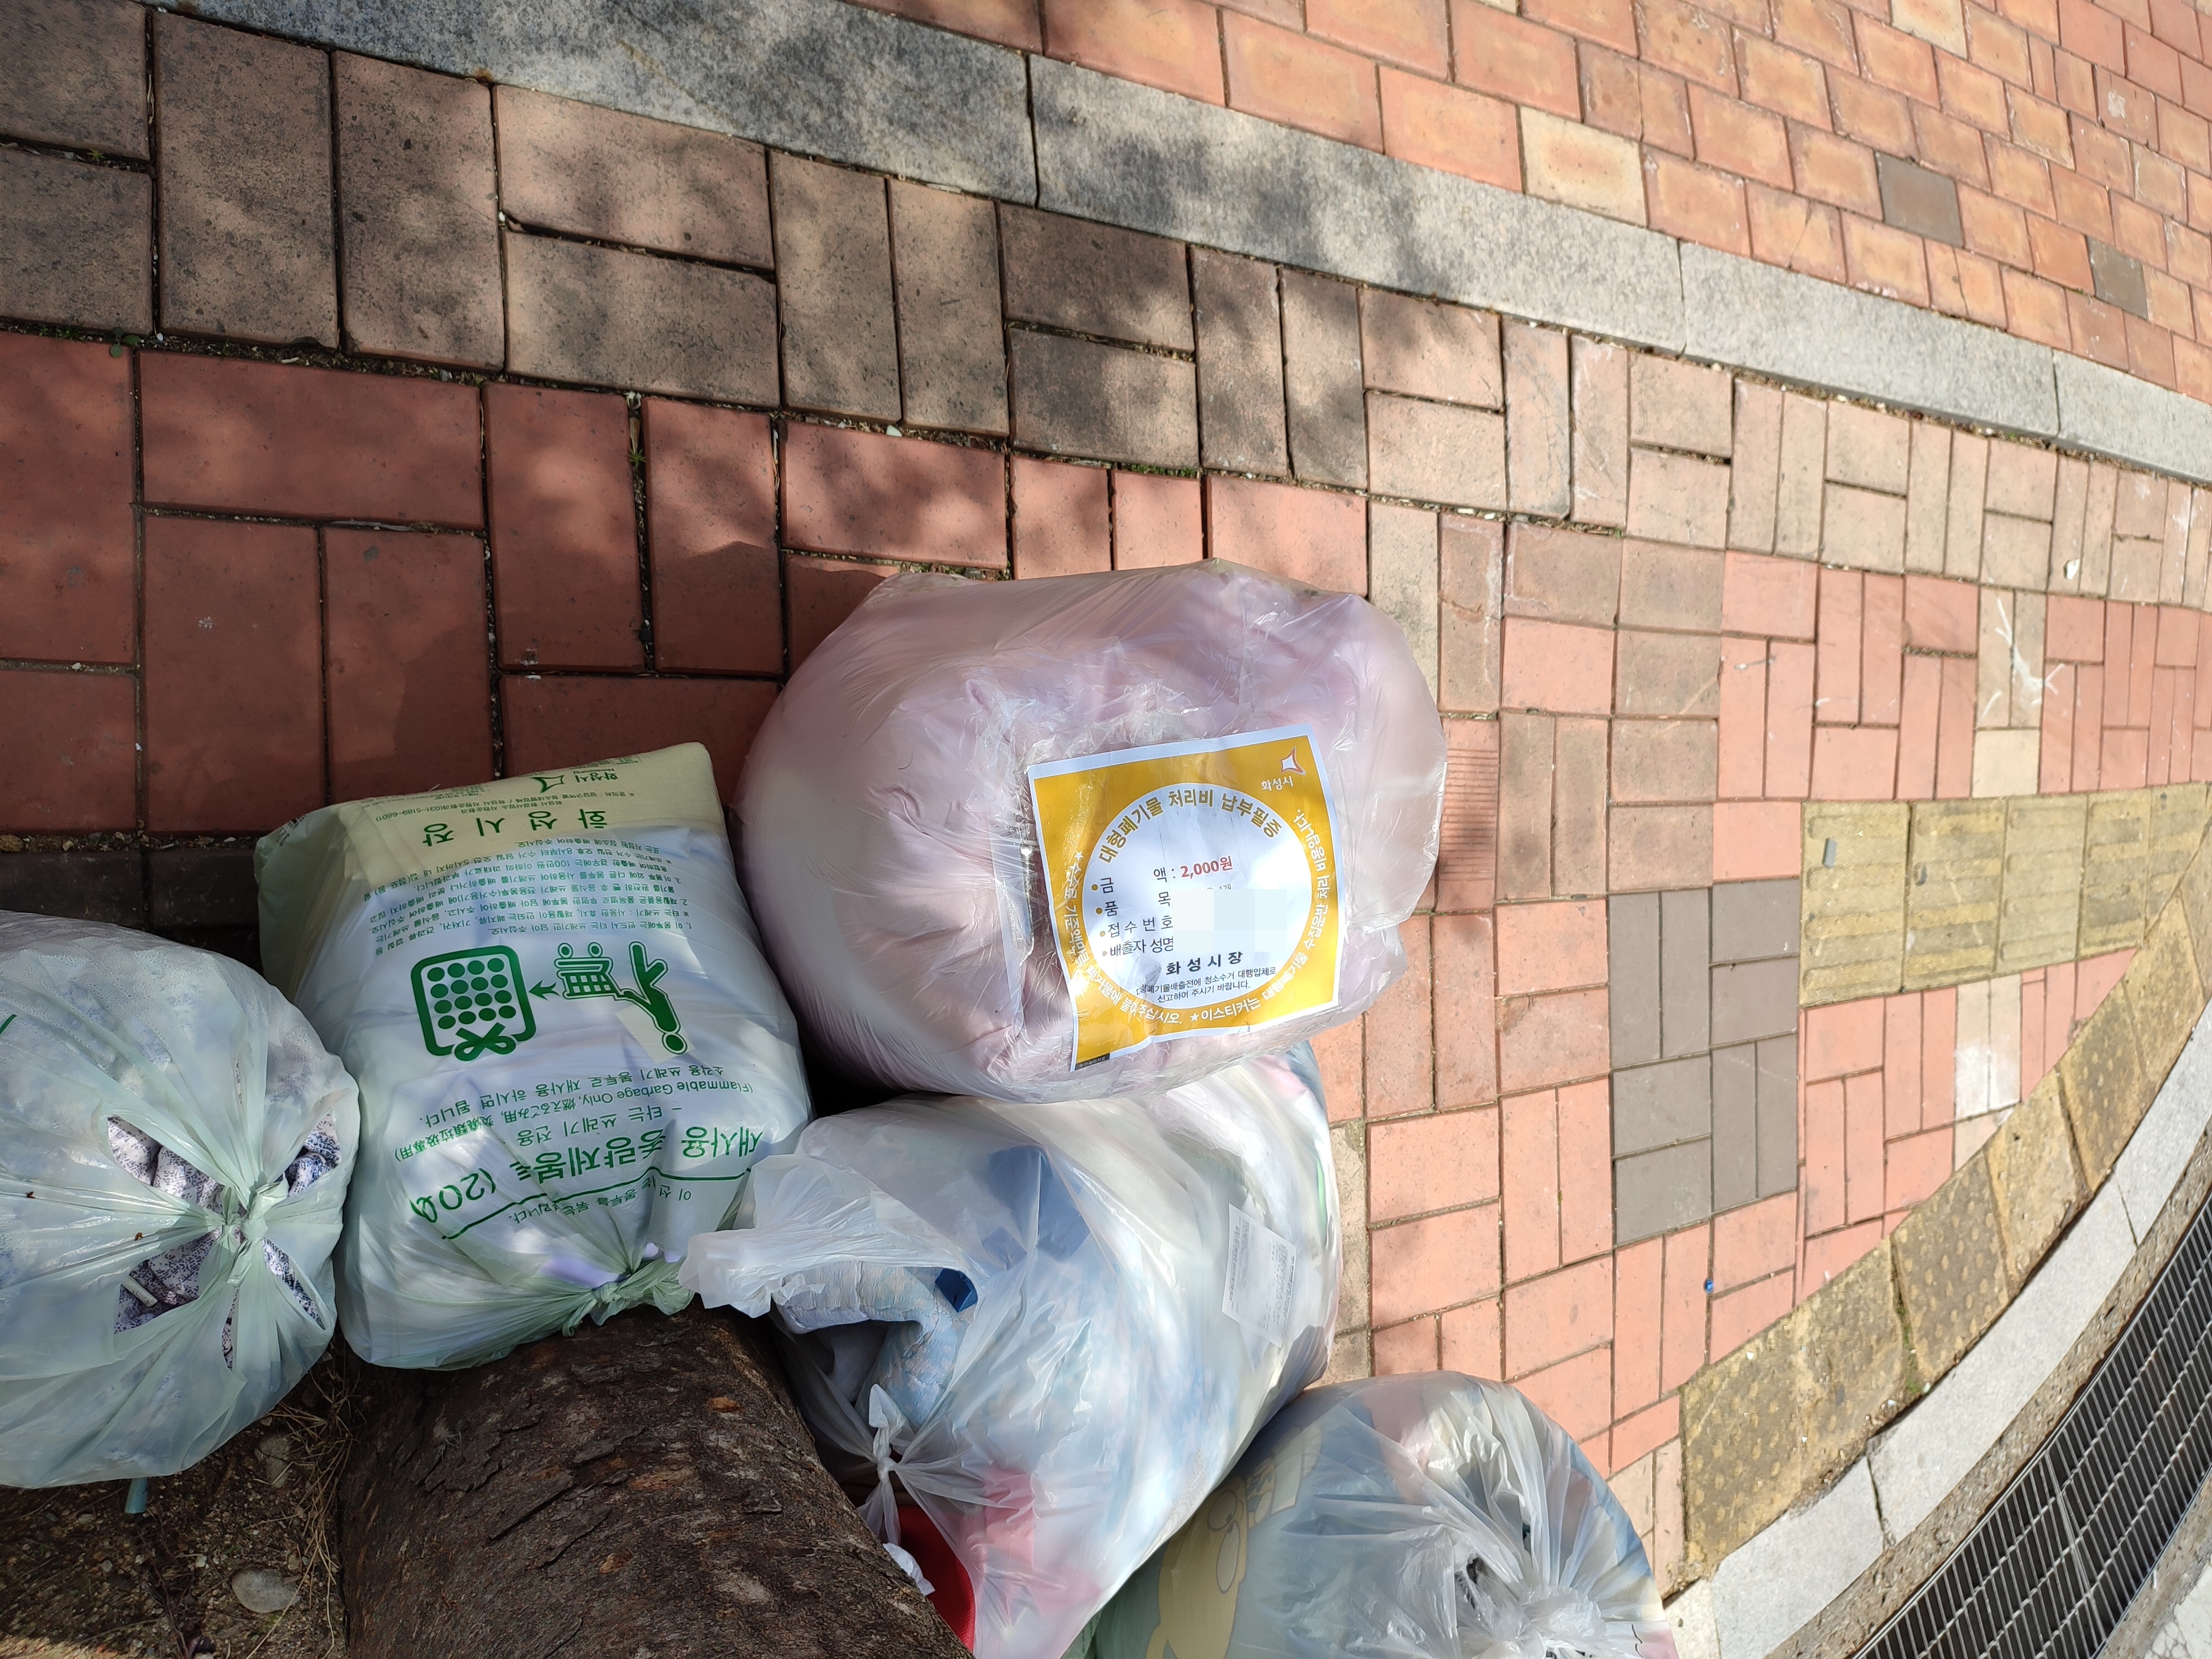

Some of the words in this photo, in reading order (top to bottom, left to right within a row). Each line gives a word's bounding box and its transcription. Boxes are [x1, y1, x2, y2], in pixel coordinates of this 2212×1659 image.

[575, 773, 618, 782] 화성시
[1261, 776, 1293, 791] 화성시
[1098, 796, 1164, 864] 대형폐기물
[1168, 789, 1213, 807] 처리비
[1221, 792, 1283, 838] 납부필증
[514, 839, 552, 848] 주십시오.
[621, 842, 642, 851] 지정된
[518, 851, 536, 859] 수거
[541, 847, 572, 856] 8시부터
[645, 846, 659, 854] 또는
[496, 853, 514, 861] 당일
[575, 858, 608, 867] 경우에는
[634, 853, 662, 863] 쓰레기는
[436, 859, 469, 873] 5시까지
[505, 863, 532, 871] 이하의
[537, 860, 570, 869] 100만원
[639, 862, 667, 872] 혼합하여
[424, 869, 432, 878] 내
[465, 865, 501, 876] 과태료가
[1100, 877, 1114, 894] 금
[1180, 855, 1233, 879] 2,000원
[390, 873, 419, 889] 집(점포
[414, 872, 460, 892] 부과됩니다.
[501, 874, 536, 884] 쓰레기를
[541, 872, 575, 881] 사용하여
[450, 878, 496, 891] 배출하거나
[541, 885, 566, 894] 쓰레기
[571, 884, 597, 893] 음식물
[625, 883, 649, 891] 완전히
[429, 887, 445, 899] 분리
[448, 887, 536, 904] 전용봉투(수거용기)에
[390, 896, 424, 915] 배출하지
[521, 899, 538, 907] 담아
[542, 898, 568, 906] 봉투에
[572, 896, 597, 905] 투명한
[602, 896, 635, 904] 품목별로
[639, 896, 677, 905] 재활용품은
[409, 901, 444, 919] 배출하여
[445, 906, 475, 917] 주시고,
[480, 901, 516, 912] 배출하여
[1104, 901, 1119, 917] 품
[370, 911, 387, 923] 않고
[508, 912, 535, 921] 안되는
[539, 910, 573, 919] 재활용이
[578, 909, 597, 917] 휴지,
[369, 916, 405, 934] 주십시오.
[414, 912, 440, 928] 음식물
[440, 920, 470, 931] 기저귀,
[612, 921, 635, 930] 반드시
[488, 925, 526, 935] 주십시오.
[531, 924, 549, 932] 담아
[553, 922, 586, 931] 쓰레기만
[376, 924, 410, 943] 쓰레기는
[409, 926, 435, 941] 견과류
[388, 938, 404, 951] 껍질
[1110, 939, 1146, 957] 배출자
[1150, 936, 1173, 954] 성명
[1201, 995, 1261, 1021] 이스티커는
[1261, 951, 1309, 1001] 대형폐기물
[1316, 875, 1330, 899] 처리
[375, 947, 383, 956] 등
[1204, 971, 1234, 984] 청소수거
[1238, 967, 1277, 978] 대행업체로
[1157, 991, 1189, 1003] 신고하여
[1191, 985, 1214, 997] 주시기
[1217, 980, 1250, 992] 바랍니다.
[640, 1067, 681, 1081] 쓰레기
[688, 1065, 724, 1076] 소각용
[588, 1072, 633, 1088] 봉투로
[535, 1079, 580, 1097] 재사용
[617, 1083, 673, 1100] Garbage
[677, 1081, 753, 1094] (Flammable
[480, 1089, 526, 1109] 하시면
[578, 1092, 613, 1107] Only,
[419, 1099, 471, 1128] 됩니다.
[628, 1105, 662, 1122] 타는
[564, 1113, 617, 1136] 쓰레기
[517, 1124, 552, 1146] 전용
[681, 1126, 763, 1158] 재사용
